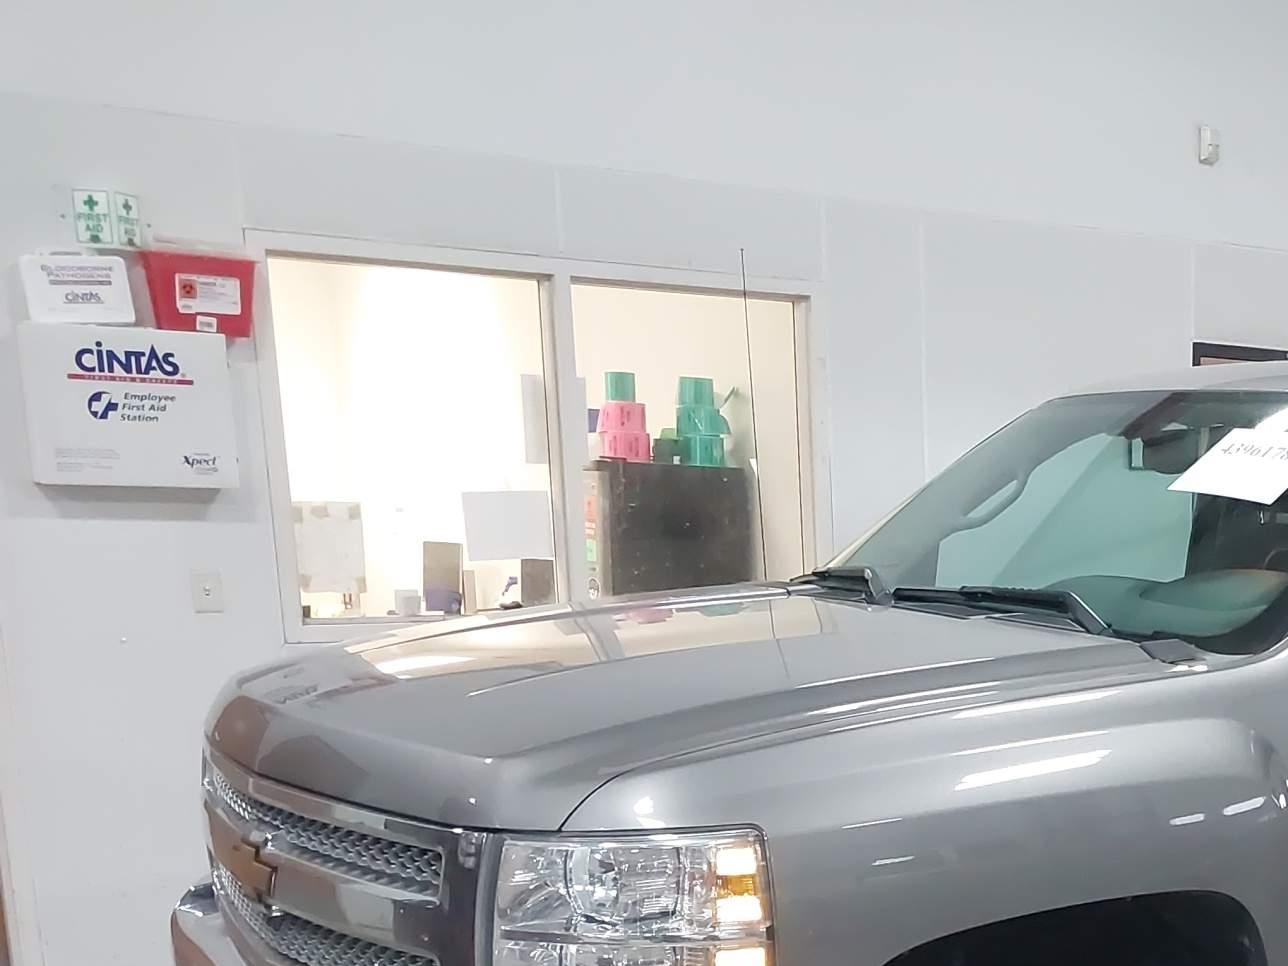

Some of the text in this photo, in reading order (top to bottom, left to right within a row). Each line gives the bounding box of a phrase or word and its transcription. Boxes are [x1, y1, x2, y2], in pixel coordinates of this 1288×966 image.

[77, 212, 107, 223] FIRST
[85, 223, 104, 233] AID
[75, 341, 180, 377] CINTAS
[124, 392, 176, 403] Employee
[122, 403, 167, 412] First Aid
[120, 413, 159, 422] Station
